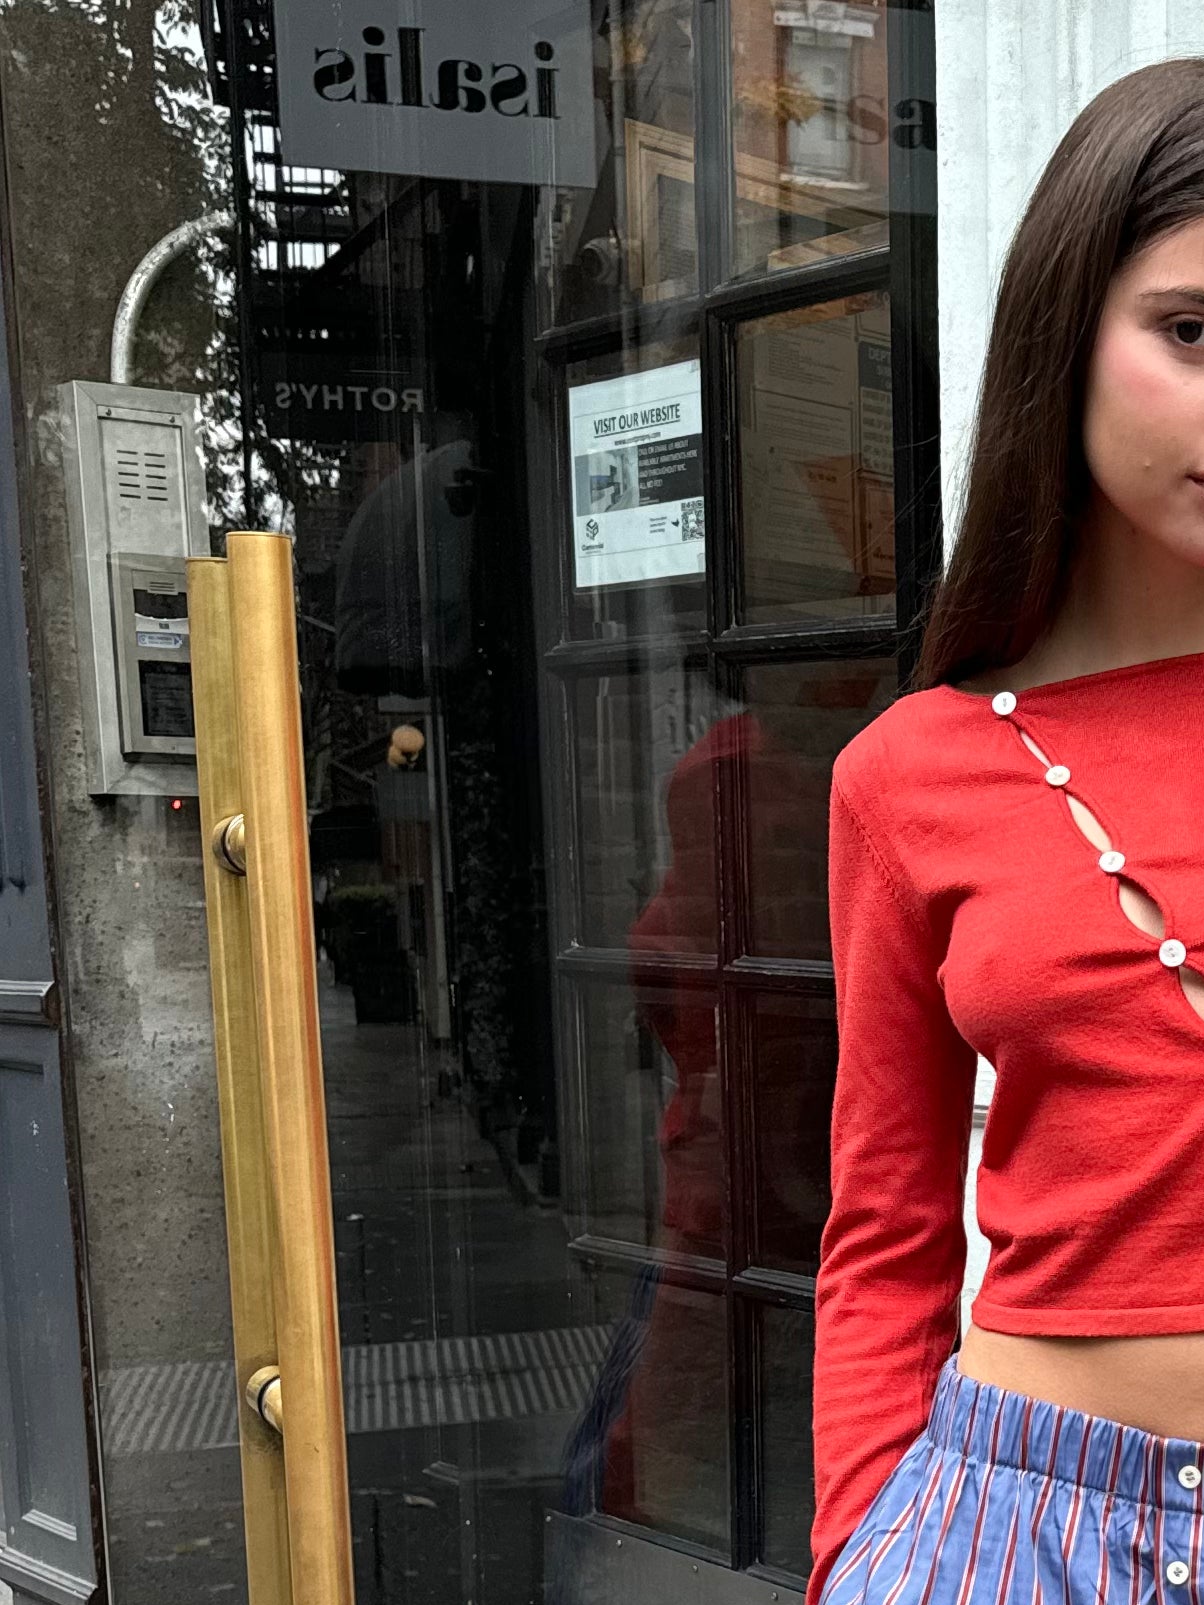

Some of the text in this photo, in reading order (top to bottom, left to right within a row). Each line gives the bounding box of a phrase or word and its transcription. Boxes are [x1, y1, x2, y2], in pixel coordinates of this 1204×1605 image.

[594, 403, 680, 435] VISIT OUR WEBSITE
